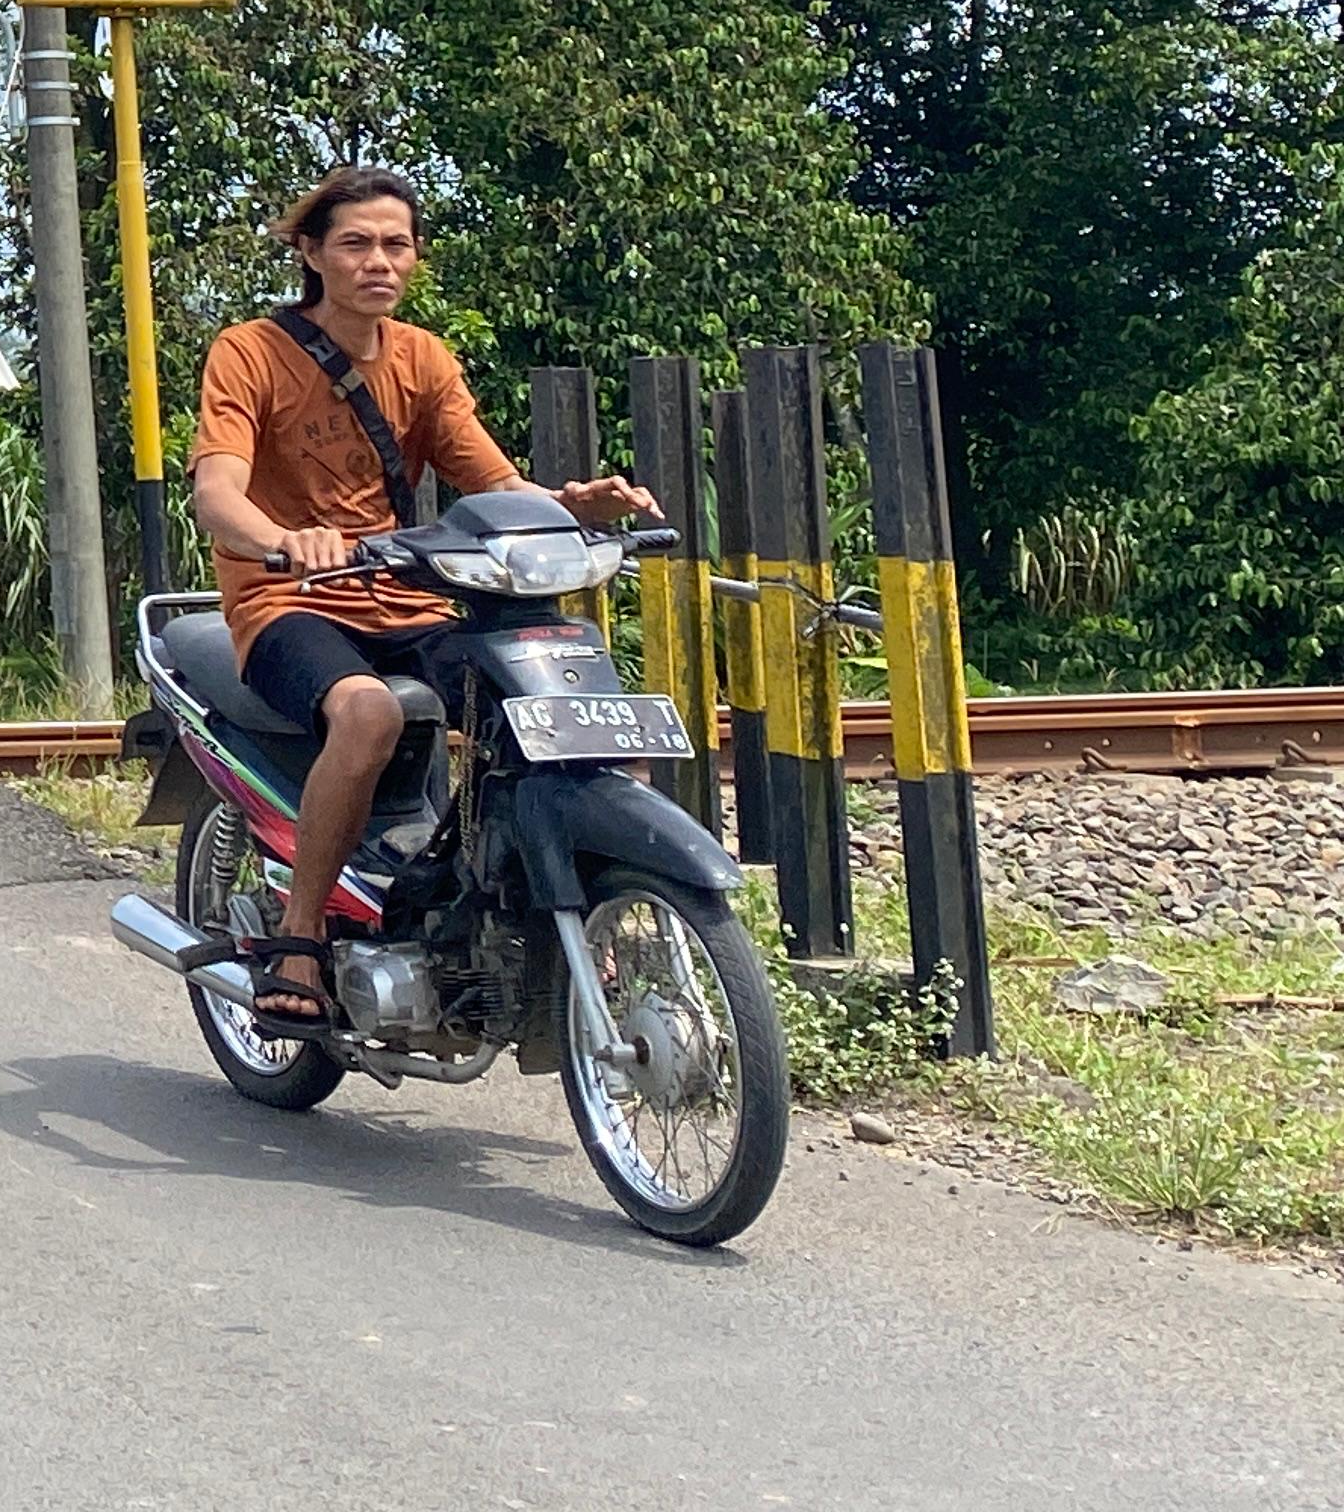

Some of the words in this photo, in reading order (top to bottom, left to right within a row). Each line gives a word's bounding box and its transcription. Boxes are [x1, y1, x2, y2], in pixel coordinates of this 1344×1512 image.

[517, 702, 553, 730] AG
[570, 700, 638, 726] 3439
[653, 700, 675, 725] T
